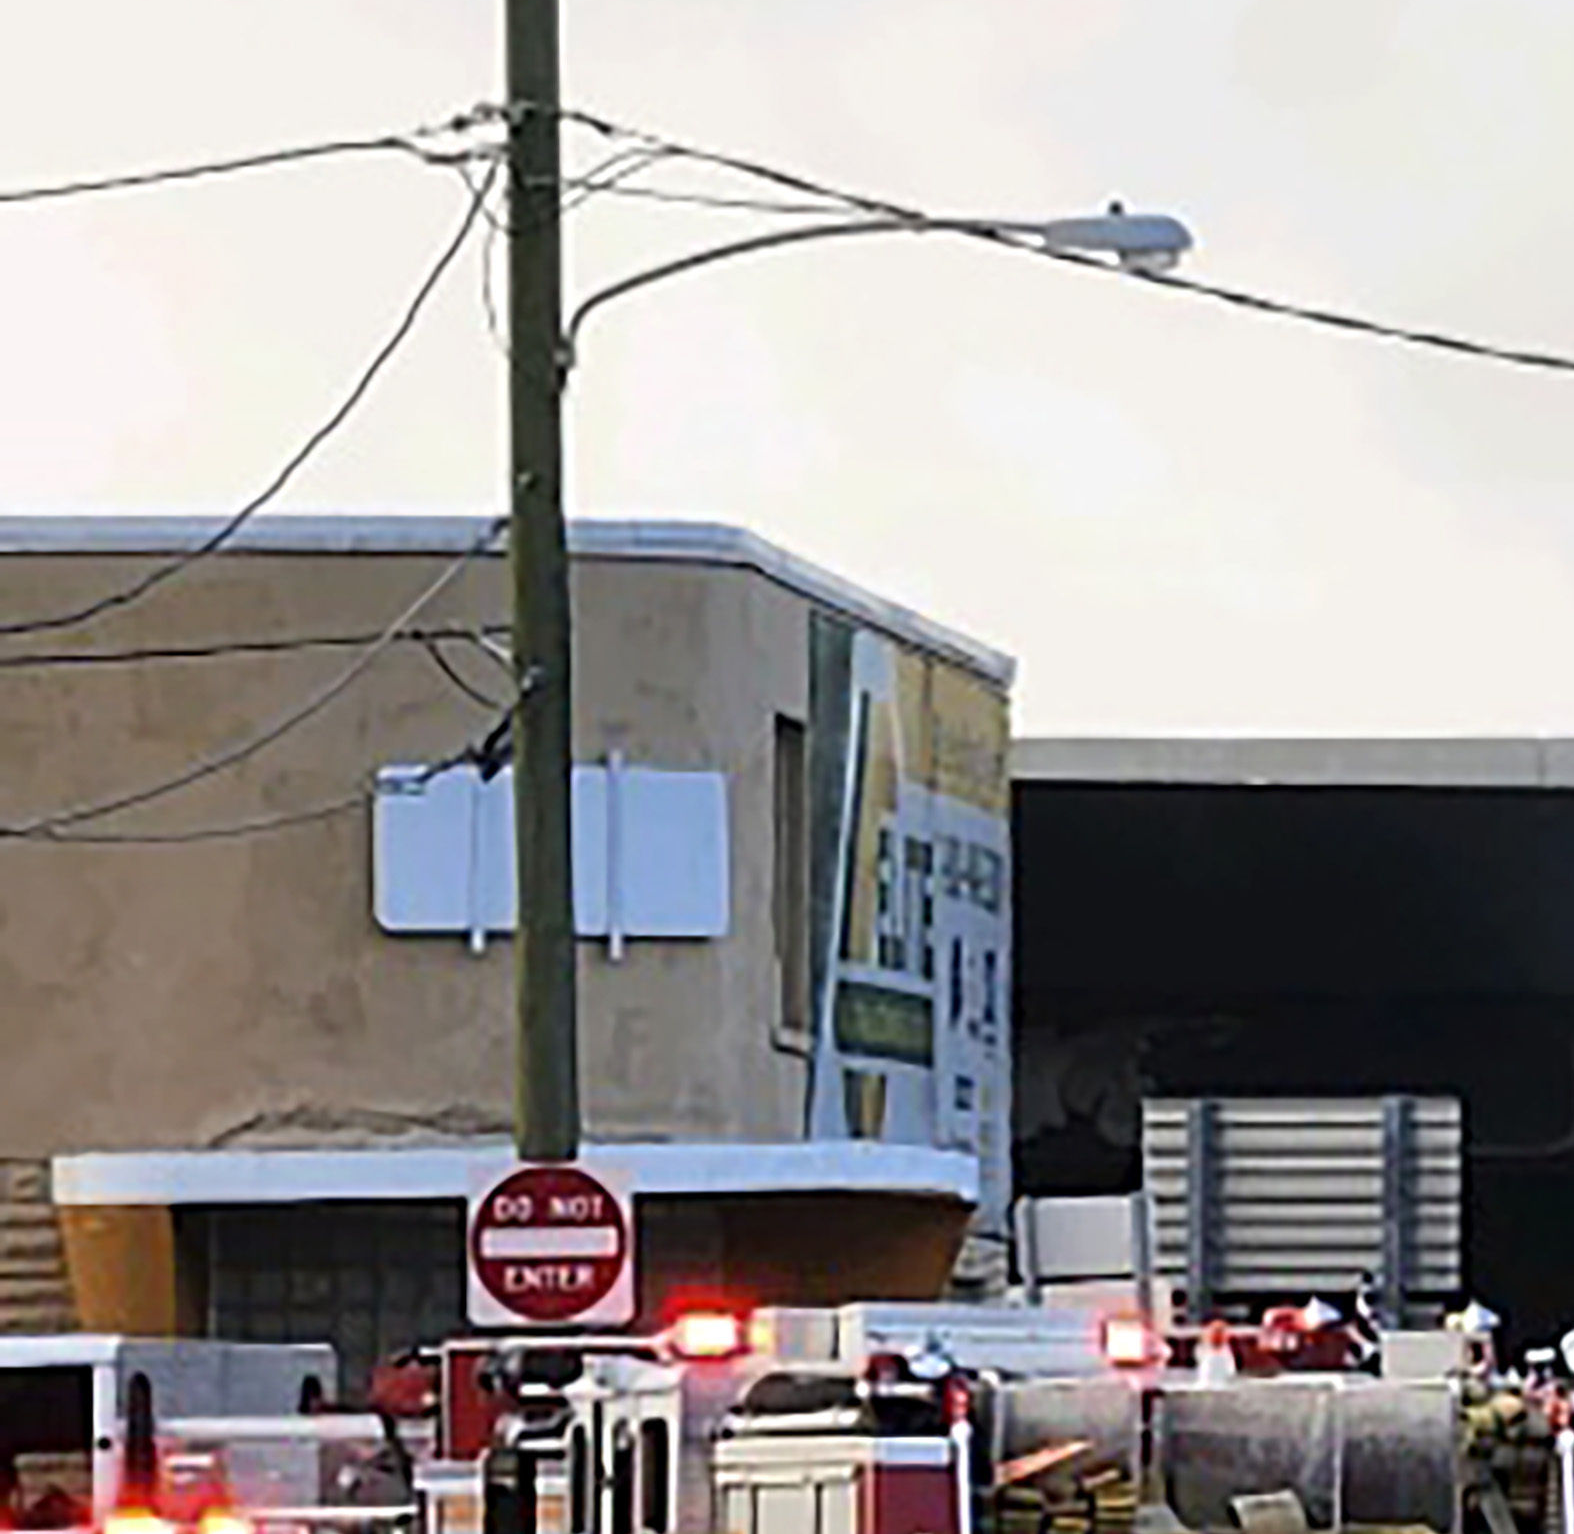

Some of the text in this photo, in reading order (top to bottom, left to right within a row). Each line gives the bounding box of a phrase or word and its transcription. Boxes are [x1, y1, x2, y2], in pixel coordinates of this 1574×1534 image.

[493, 1195, 604, 1222] DO NOT
[504, 1265, 595, 1293] ENTER
